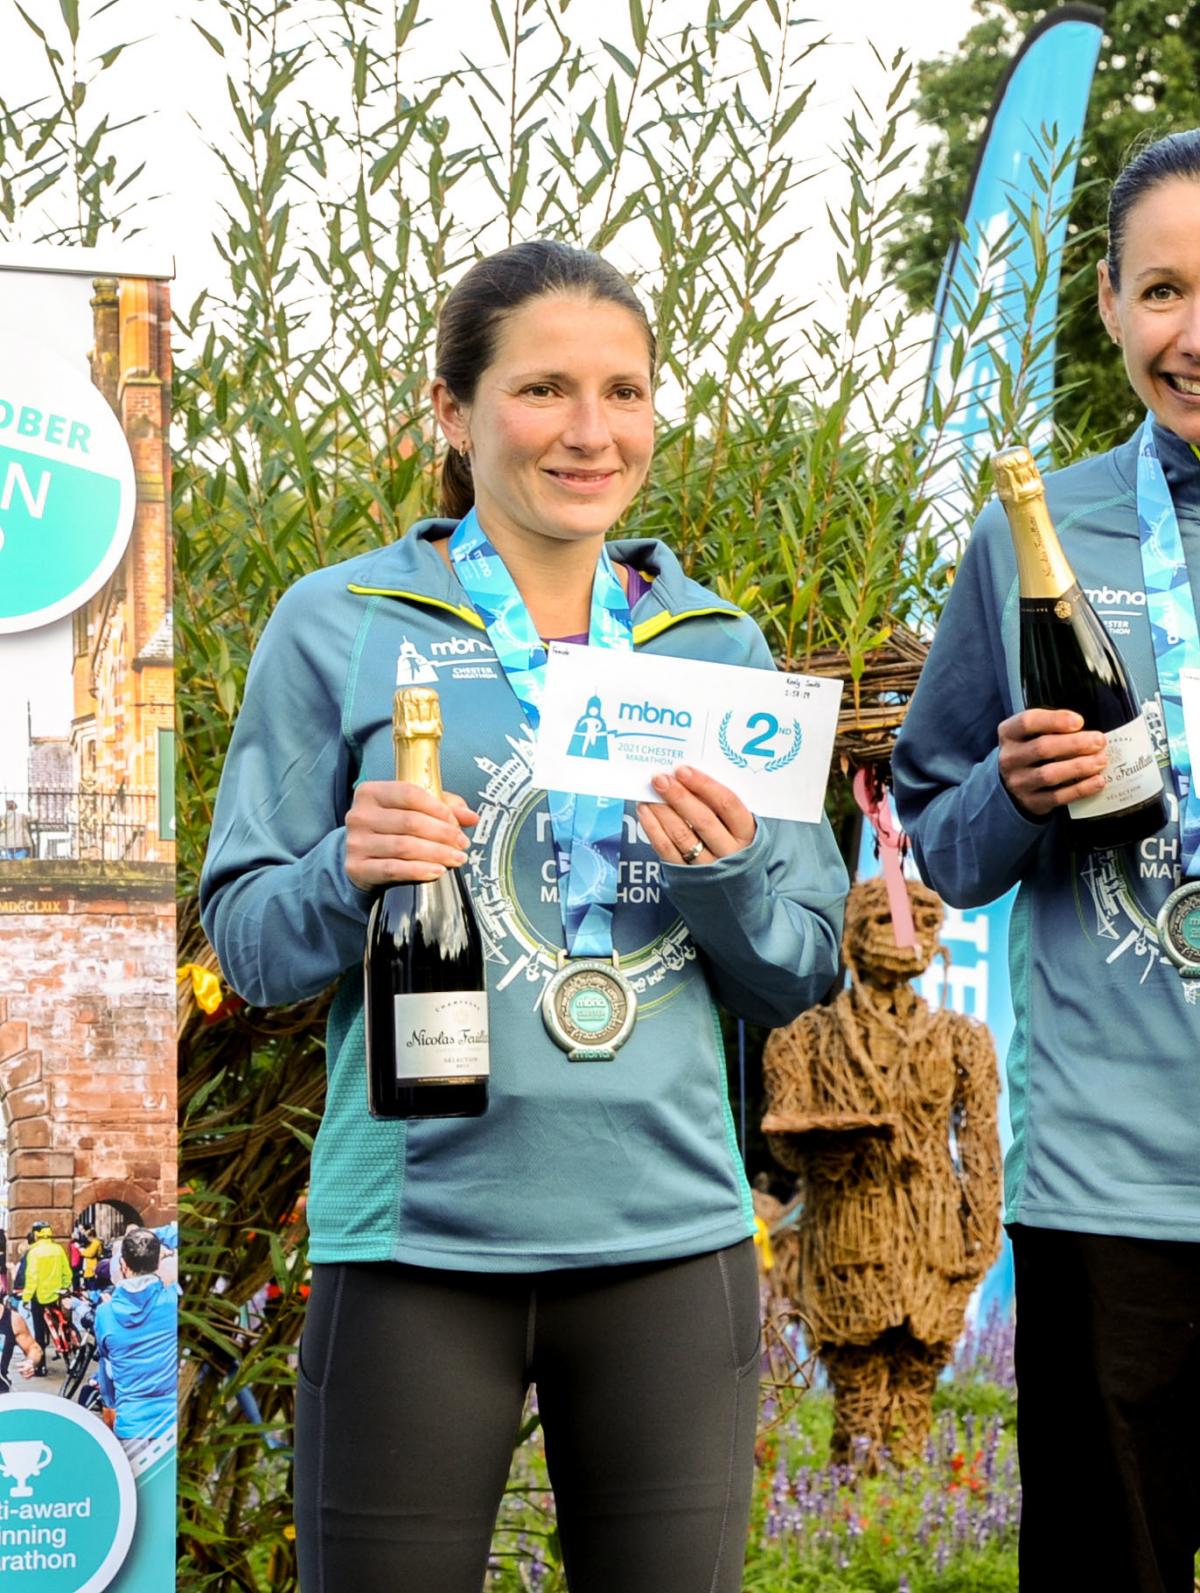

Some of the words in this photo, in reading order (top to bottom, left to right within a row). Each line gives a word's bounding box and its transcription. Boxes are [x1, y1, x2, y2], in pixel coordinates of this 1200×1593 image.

[618, 701, 693, 729] mbna
[617, 742, 641, 755] 2021
[641, 746, 685, 760] CHESTER
[625, 753, 674, 767] MARATHON
[406, 1029, 456, 1048] Nicolas
